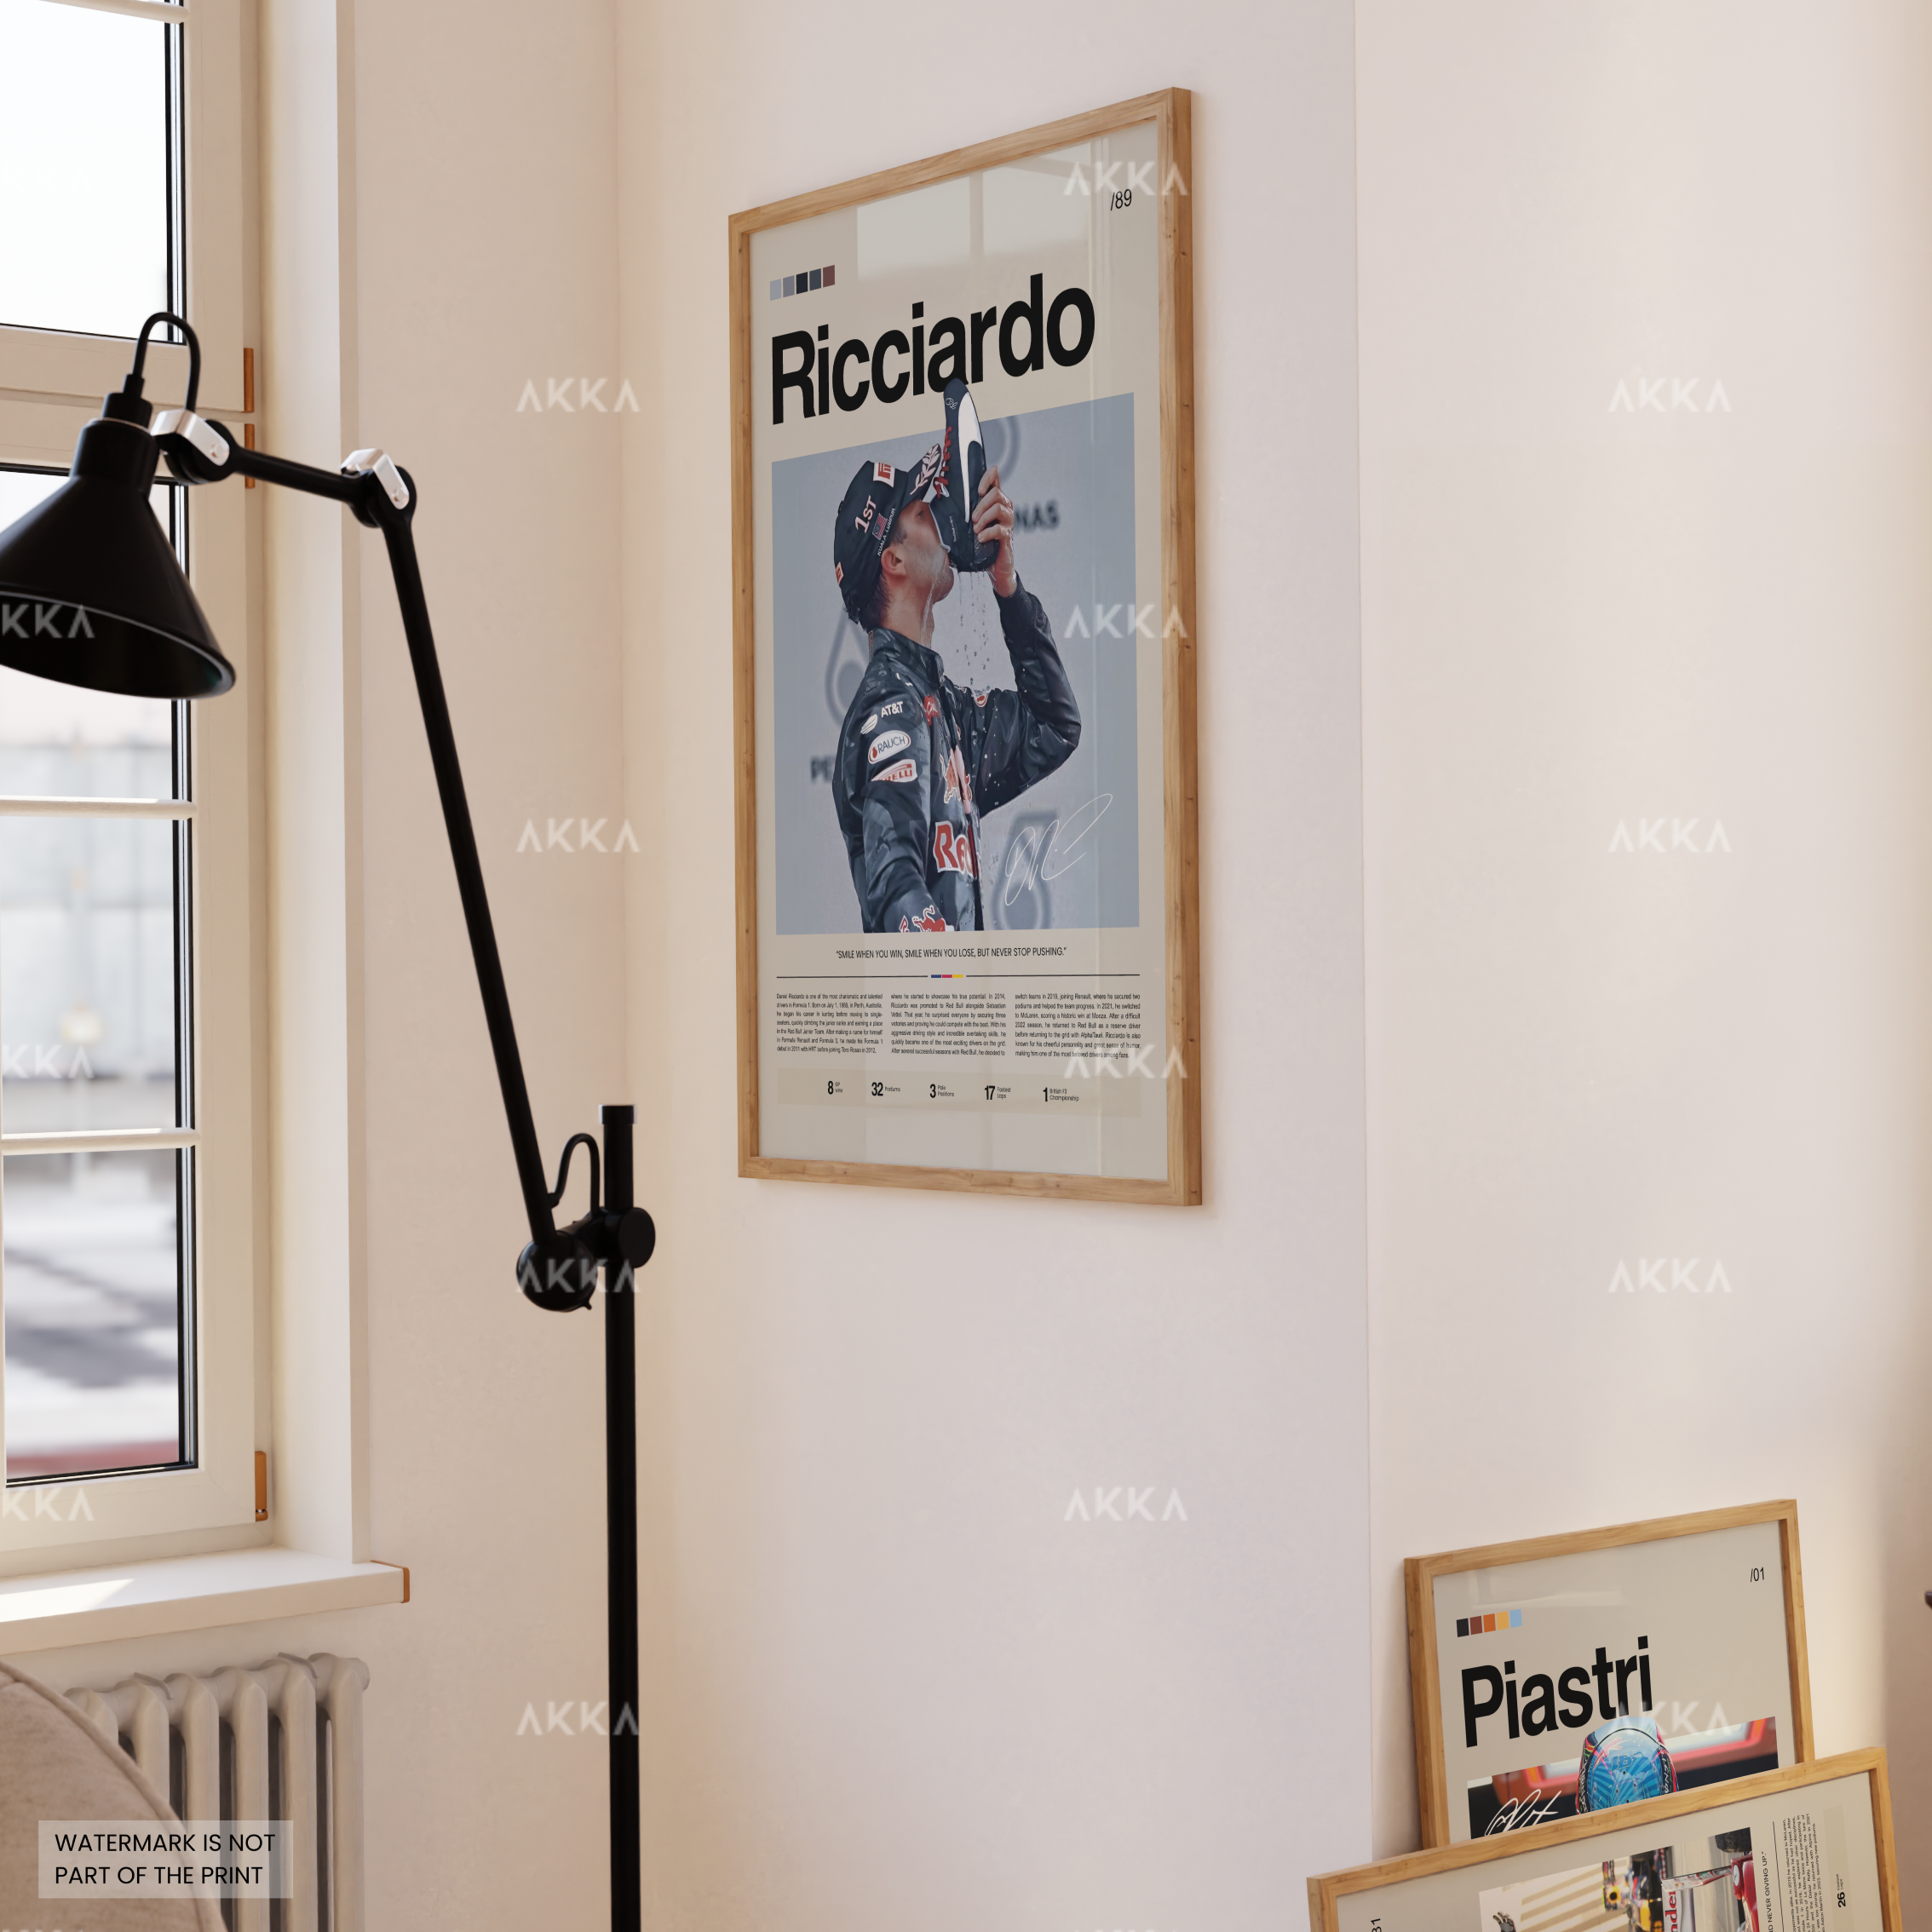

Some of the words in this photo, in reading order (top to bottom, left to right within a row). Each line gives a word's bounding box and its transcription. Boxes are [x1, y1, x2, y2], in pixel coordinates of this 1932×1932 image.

[1111, 189, 1132, 211] /89
[772, 273, 1095, 426] Ricciardo
[881, 701, 903, 718] AT&T
[877, 736, 906, 754] RAUCH
[835, 950, 854, 958] “SMILE
[855, 950, 874, 958] WHEN
[875, 949, 888, 957] YOU
[889, 949, 903, 958] WIN,
[905, 949, 922, 957] SMILE
[923, 948, 942, 957] WHEN
[943, 948, 957, 957] YOU
[958, 948, 975, 957] LOSE,
[977, 947, 990, 957] BUT
[991, 947, 1012, 956] NEVER
[1013, 947, 1031, 956] STOP
[1032, 946, 1067, 956] PUSHING.”
[828, 1080, 833, 1095] 8
[871, 1082, 883, 1096] 32
[930, 1084, 936, 1098] 3
[985, 1085, 995, 1100] 17
[1043, 1087, 1048, 1102] 1
[1750, 1567, 1765, 1583] /01
[1461, 1635, 1653, 1748] Piastri
[1837, 1892, 1846, 1907] 26
